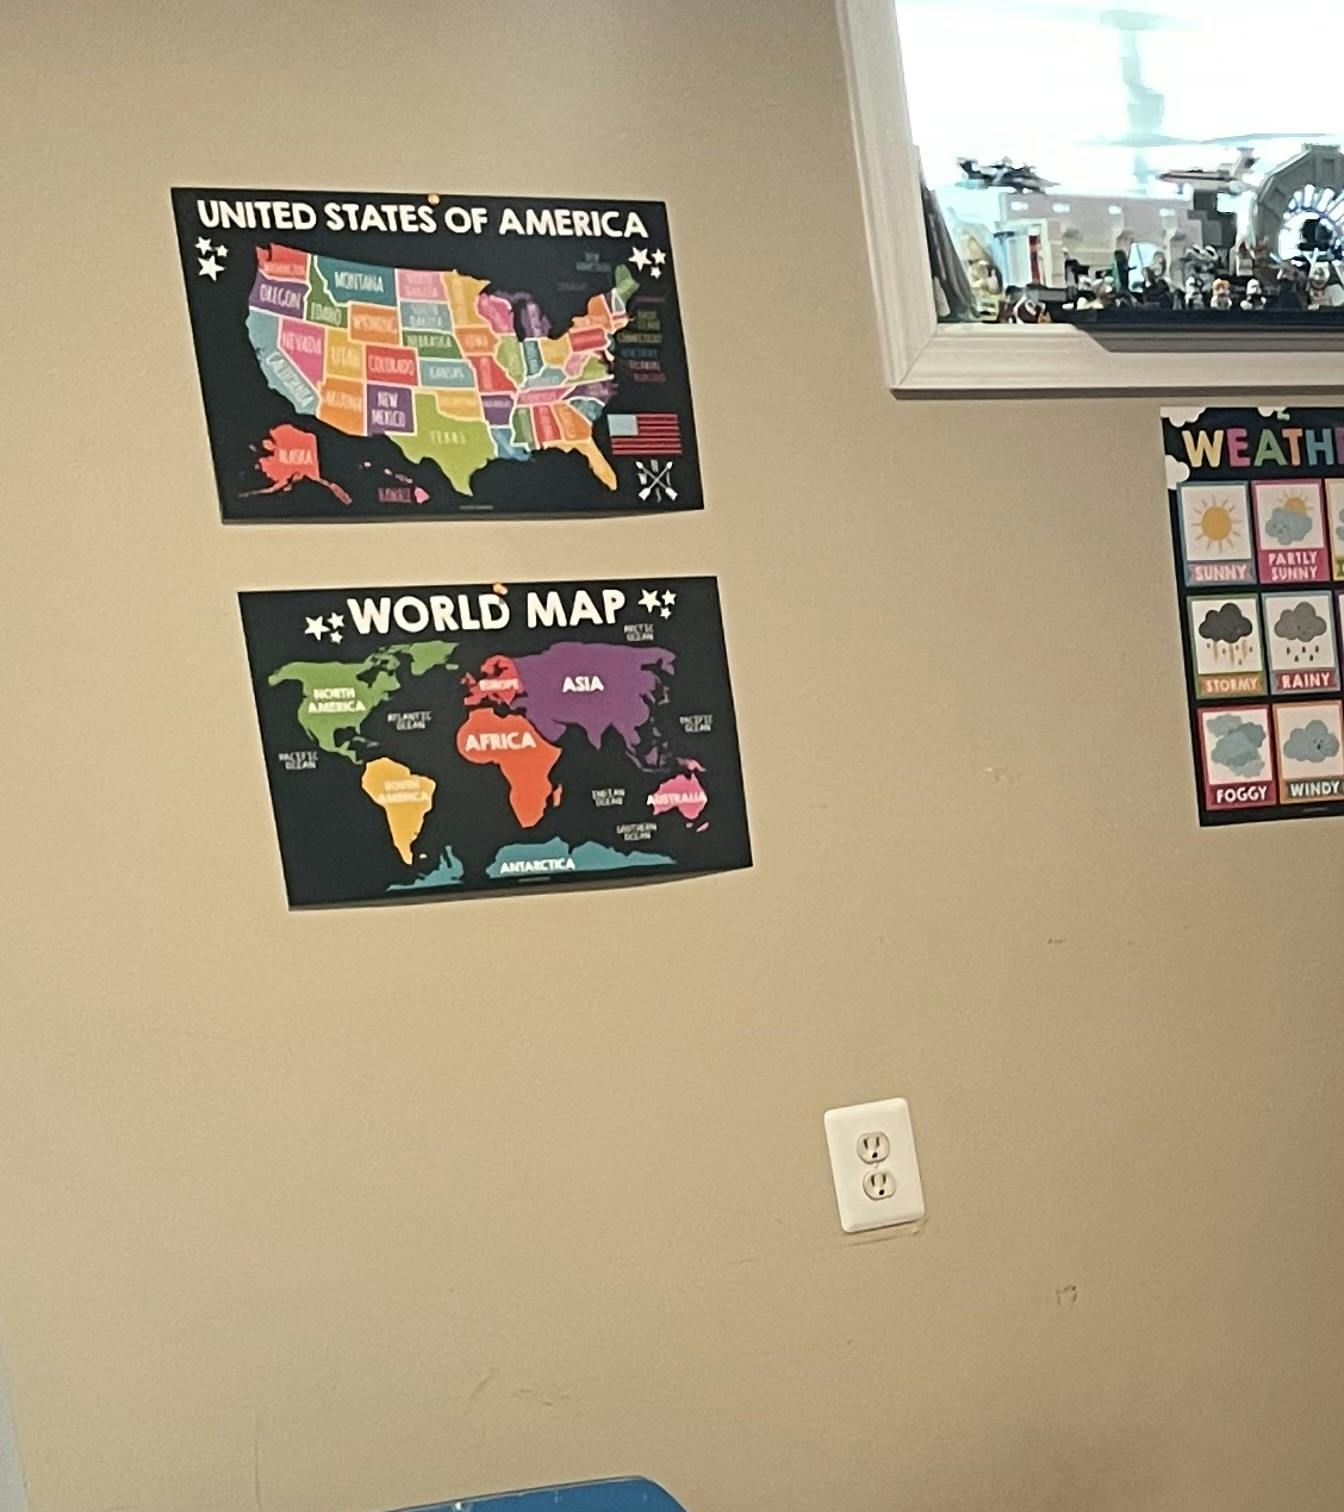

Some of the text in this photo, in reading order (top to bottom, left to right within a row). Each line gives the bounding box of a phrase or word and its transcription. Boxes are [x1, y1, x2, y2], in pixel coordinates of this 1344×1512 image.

[197, 200, 649, 238] UNITED STATES OF AMERICA
[1268, 551, 1317, 566] PARTLY
[1194, 564, 1248, 581] SUNNY
[1271, 566, 1318, 581] SUNNY
[346, 589, 626, 635] WORLD MAP
[561, 676, 604, 693] ASIA
[1206, 678, 1258, 693] STORMY
[1282, 672, 1331, 689] RAINY
[313, 687, 356, 700] NORTH
[308, 700, 366, 715] AMERICA
[464, 731, 537, 752] AFRICA
[1217, 785, 1268, 803] FOGGY
[1289, 781, 1340, 798] WINDY
[647, 792, 708, 806] AUSTRALIA
[500, 858, 576, 873] ANTARCTICA
